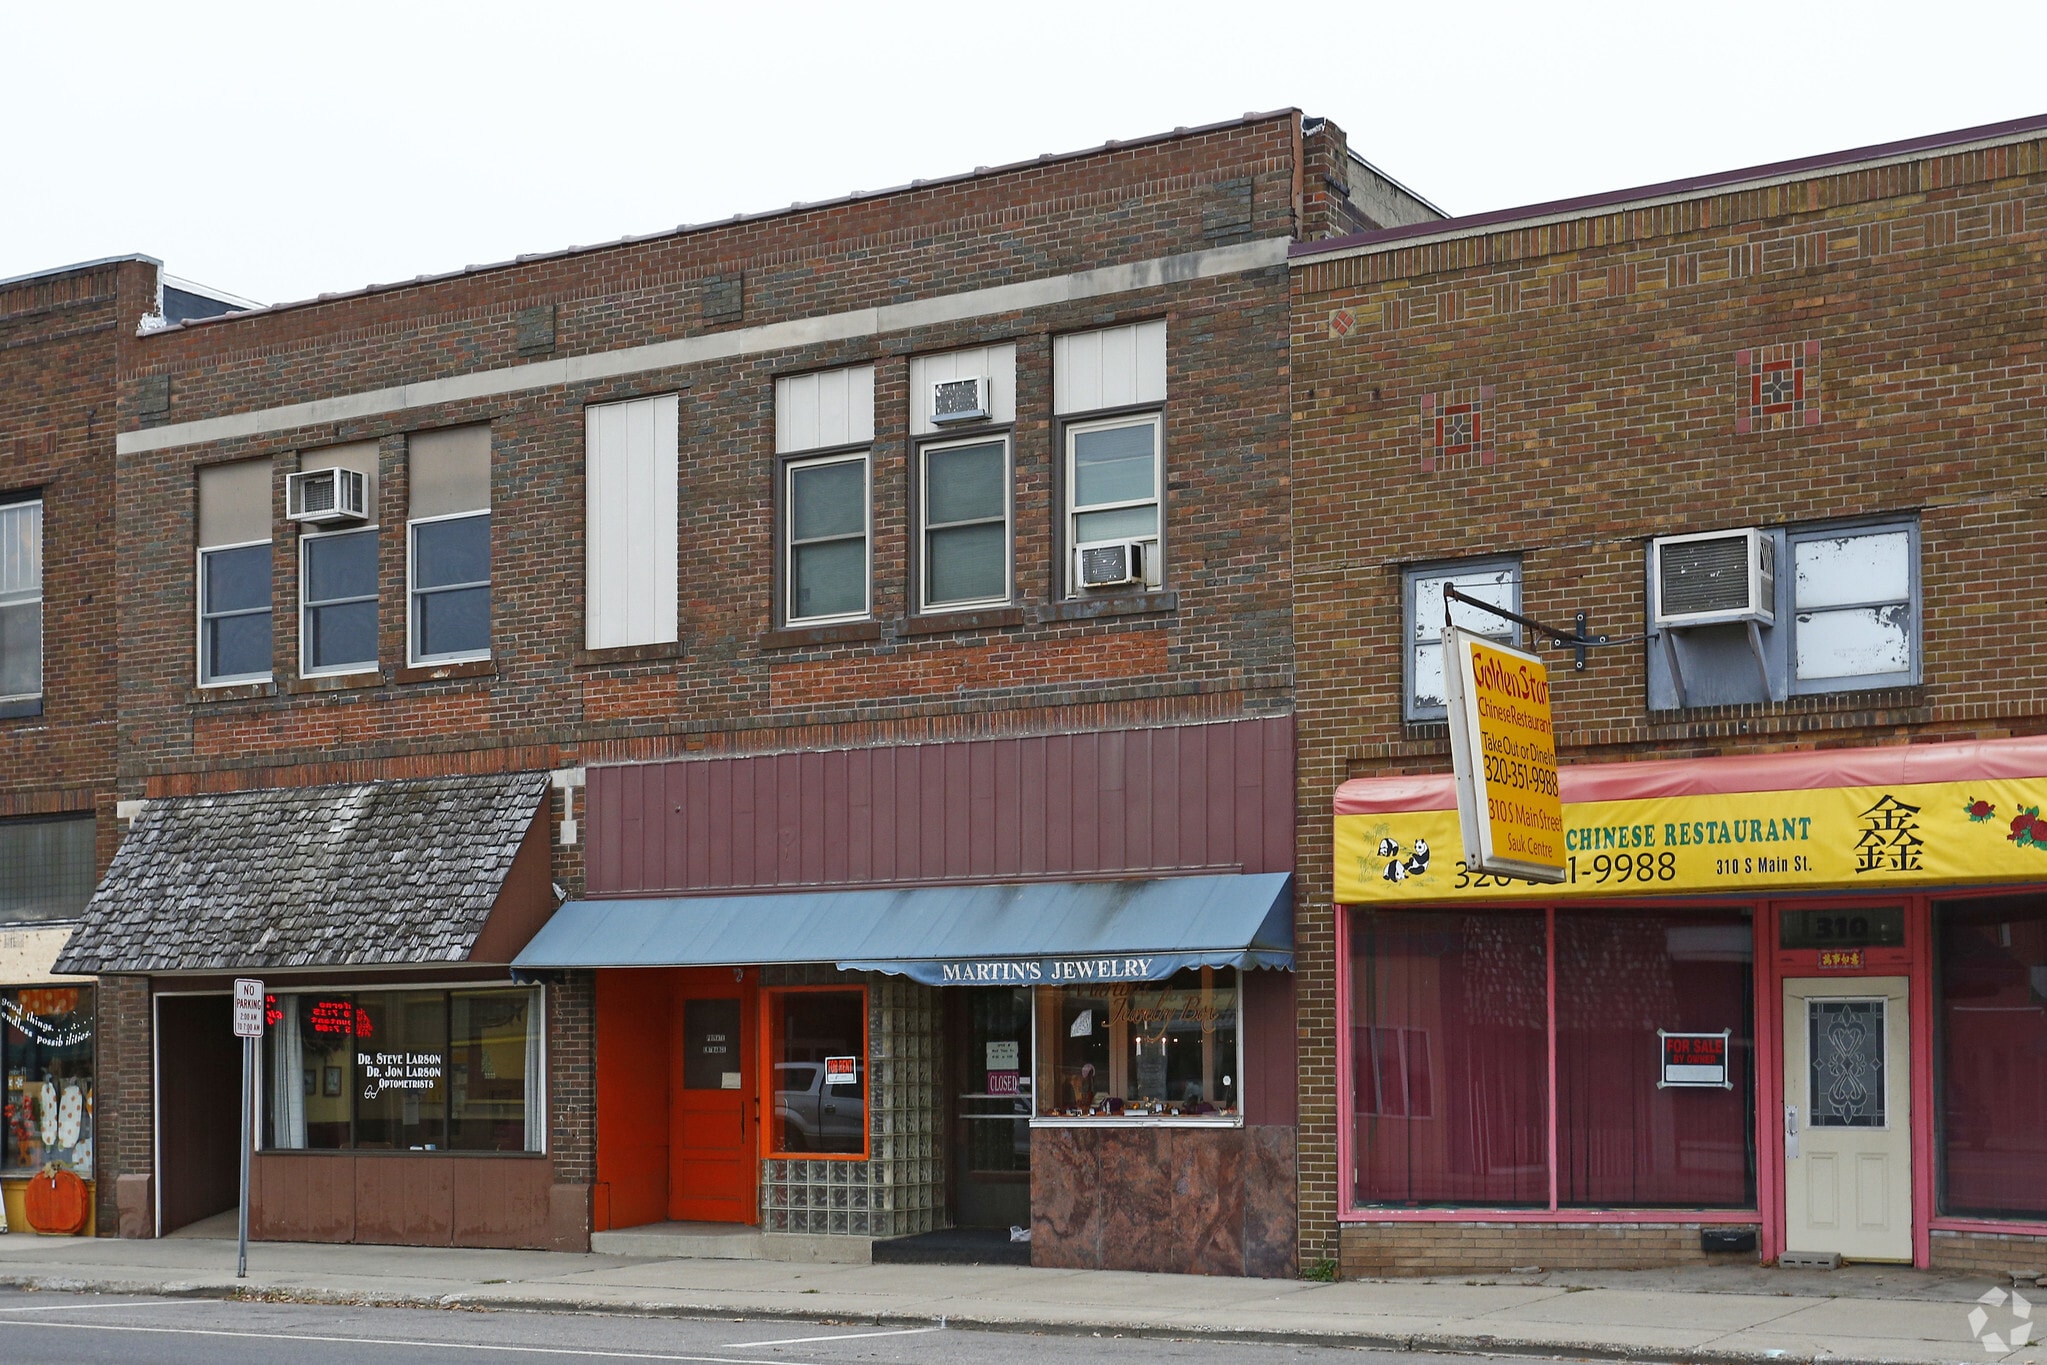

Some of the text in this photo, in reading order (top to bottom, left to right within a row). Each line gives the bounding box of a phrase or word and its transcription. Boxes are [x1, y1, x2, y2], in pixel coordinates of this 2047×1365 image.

[1472, 652, 1547, 704] Golden Star
[1478, 696, 1552, 735] Chinese Restaurant
[1481, 731, 1503, 753] Take
[1502, 736, 1520, 757] Out
[1520, 745, 1530, 759] or
[1530, 743, 1548, 765] Dine
[1484, 754, 1559, 797] 320-351-9988
[1489, 798, 1563, 832] 310 S Main Street
[1508, 833, 1553, 858] Sauk Centre
[1566, 817, 1811, 850] CHINESE RESTAURANT
[1853, 794, 1924, 874] 鑫
[1716, 855, 1813, 875] 310 S Main St.
[1816, 916, 1869, 939] 310
[942, 958, 1152, 981] MARTIN'S JEWELRY
[243, 984, 255, 996] NO
[1, 997, 23, 1016] good
[236, 998, 261, 1010] PARKING
[1101, 985, 1173, 1042] Jewelry
[1180, 996, 1219, 1034] Box
[1, 1011, 33, 1037] endless
[1666, 1038, 1723, 1054] FOR SALE
[827, 1059, 853, 1073] FOR RENT
[1673, 1054, 1716, 1065] BY OWNER
[990, 1075, 1017, 1092] CLOSED
